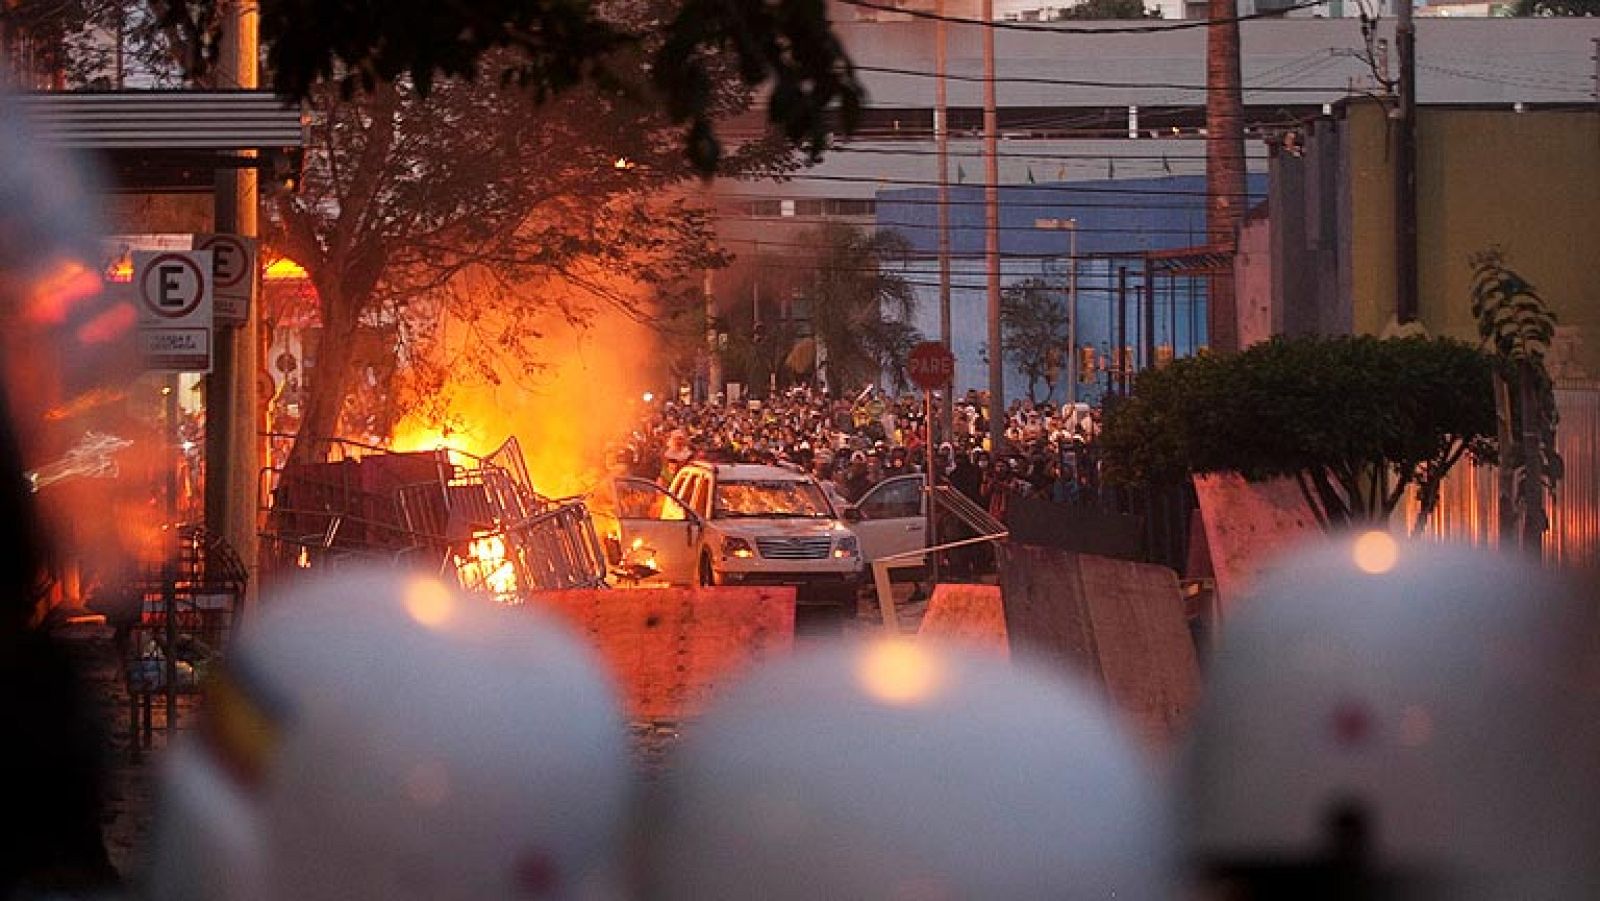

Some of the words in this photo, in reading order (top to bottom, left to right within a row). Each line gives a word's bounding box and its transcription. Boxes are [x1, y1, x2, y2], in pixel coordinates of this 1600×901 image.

[213, 245, 234, 278] E
[159, 266, 184, 306] E
[911, 357, 952, 374] PARE
